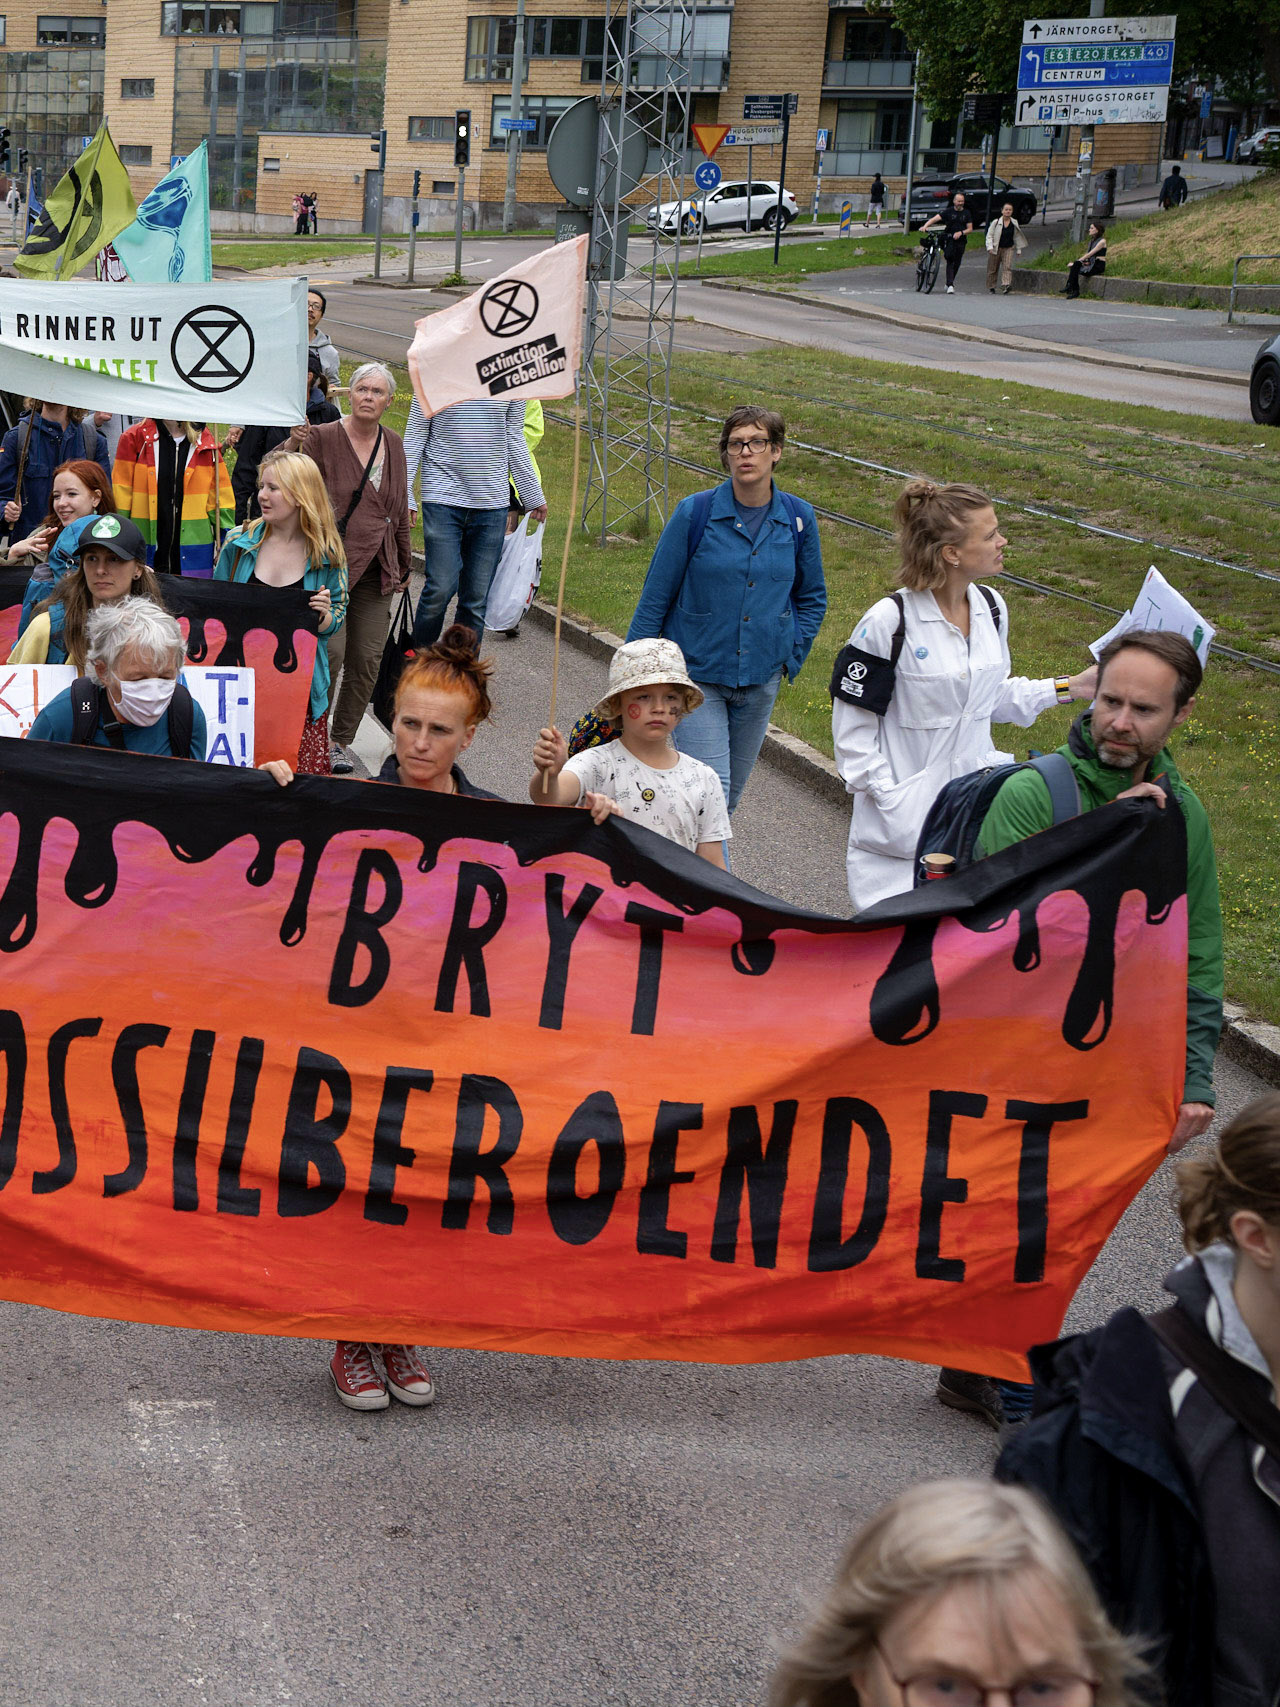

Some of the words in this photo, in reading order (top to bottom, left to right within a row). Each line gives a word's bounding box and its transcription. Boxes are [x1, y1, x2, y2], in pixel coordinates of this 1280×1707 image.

[1046, 25, 1119, 36] JÄRNTORGET
[1076, 51, 1100, 59] E20
[1113, 50, 1136, 58] E45
[1147, 49, 1164, 57] 40
[1045, 70, 1102, 80] CENTRUM
[1039, 92, 1156, 104] MASTHUGGSTORGET
[1073, 108, 1103, 116] P-hus
[16, 313, 116, 341] RINNER
[131, 317, 162, 341] UT
[480, 342, 548, 378] extinction
[504, 356, 567, 388] rebellion
[328, 848, 685, 1036] BRYT
